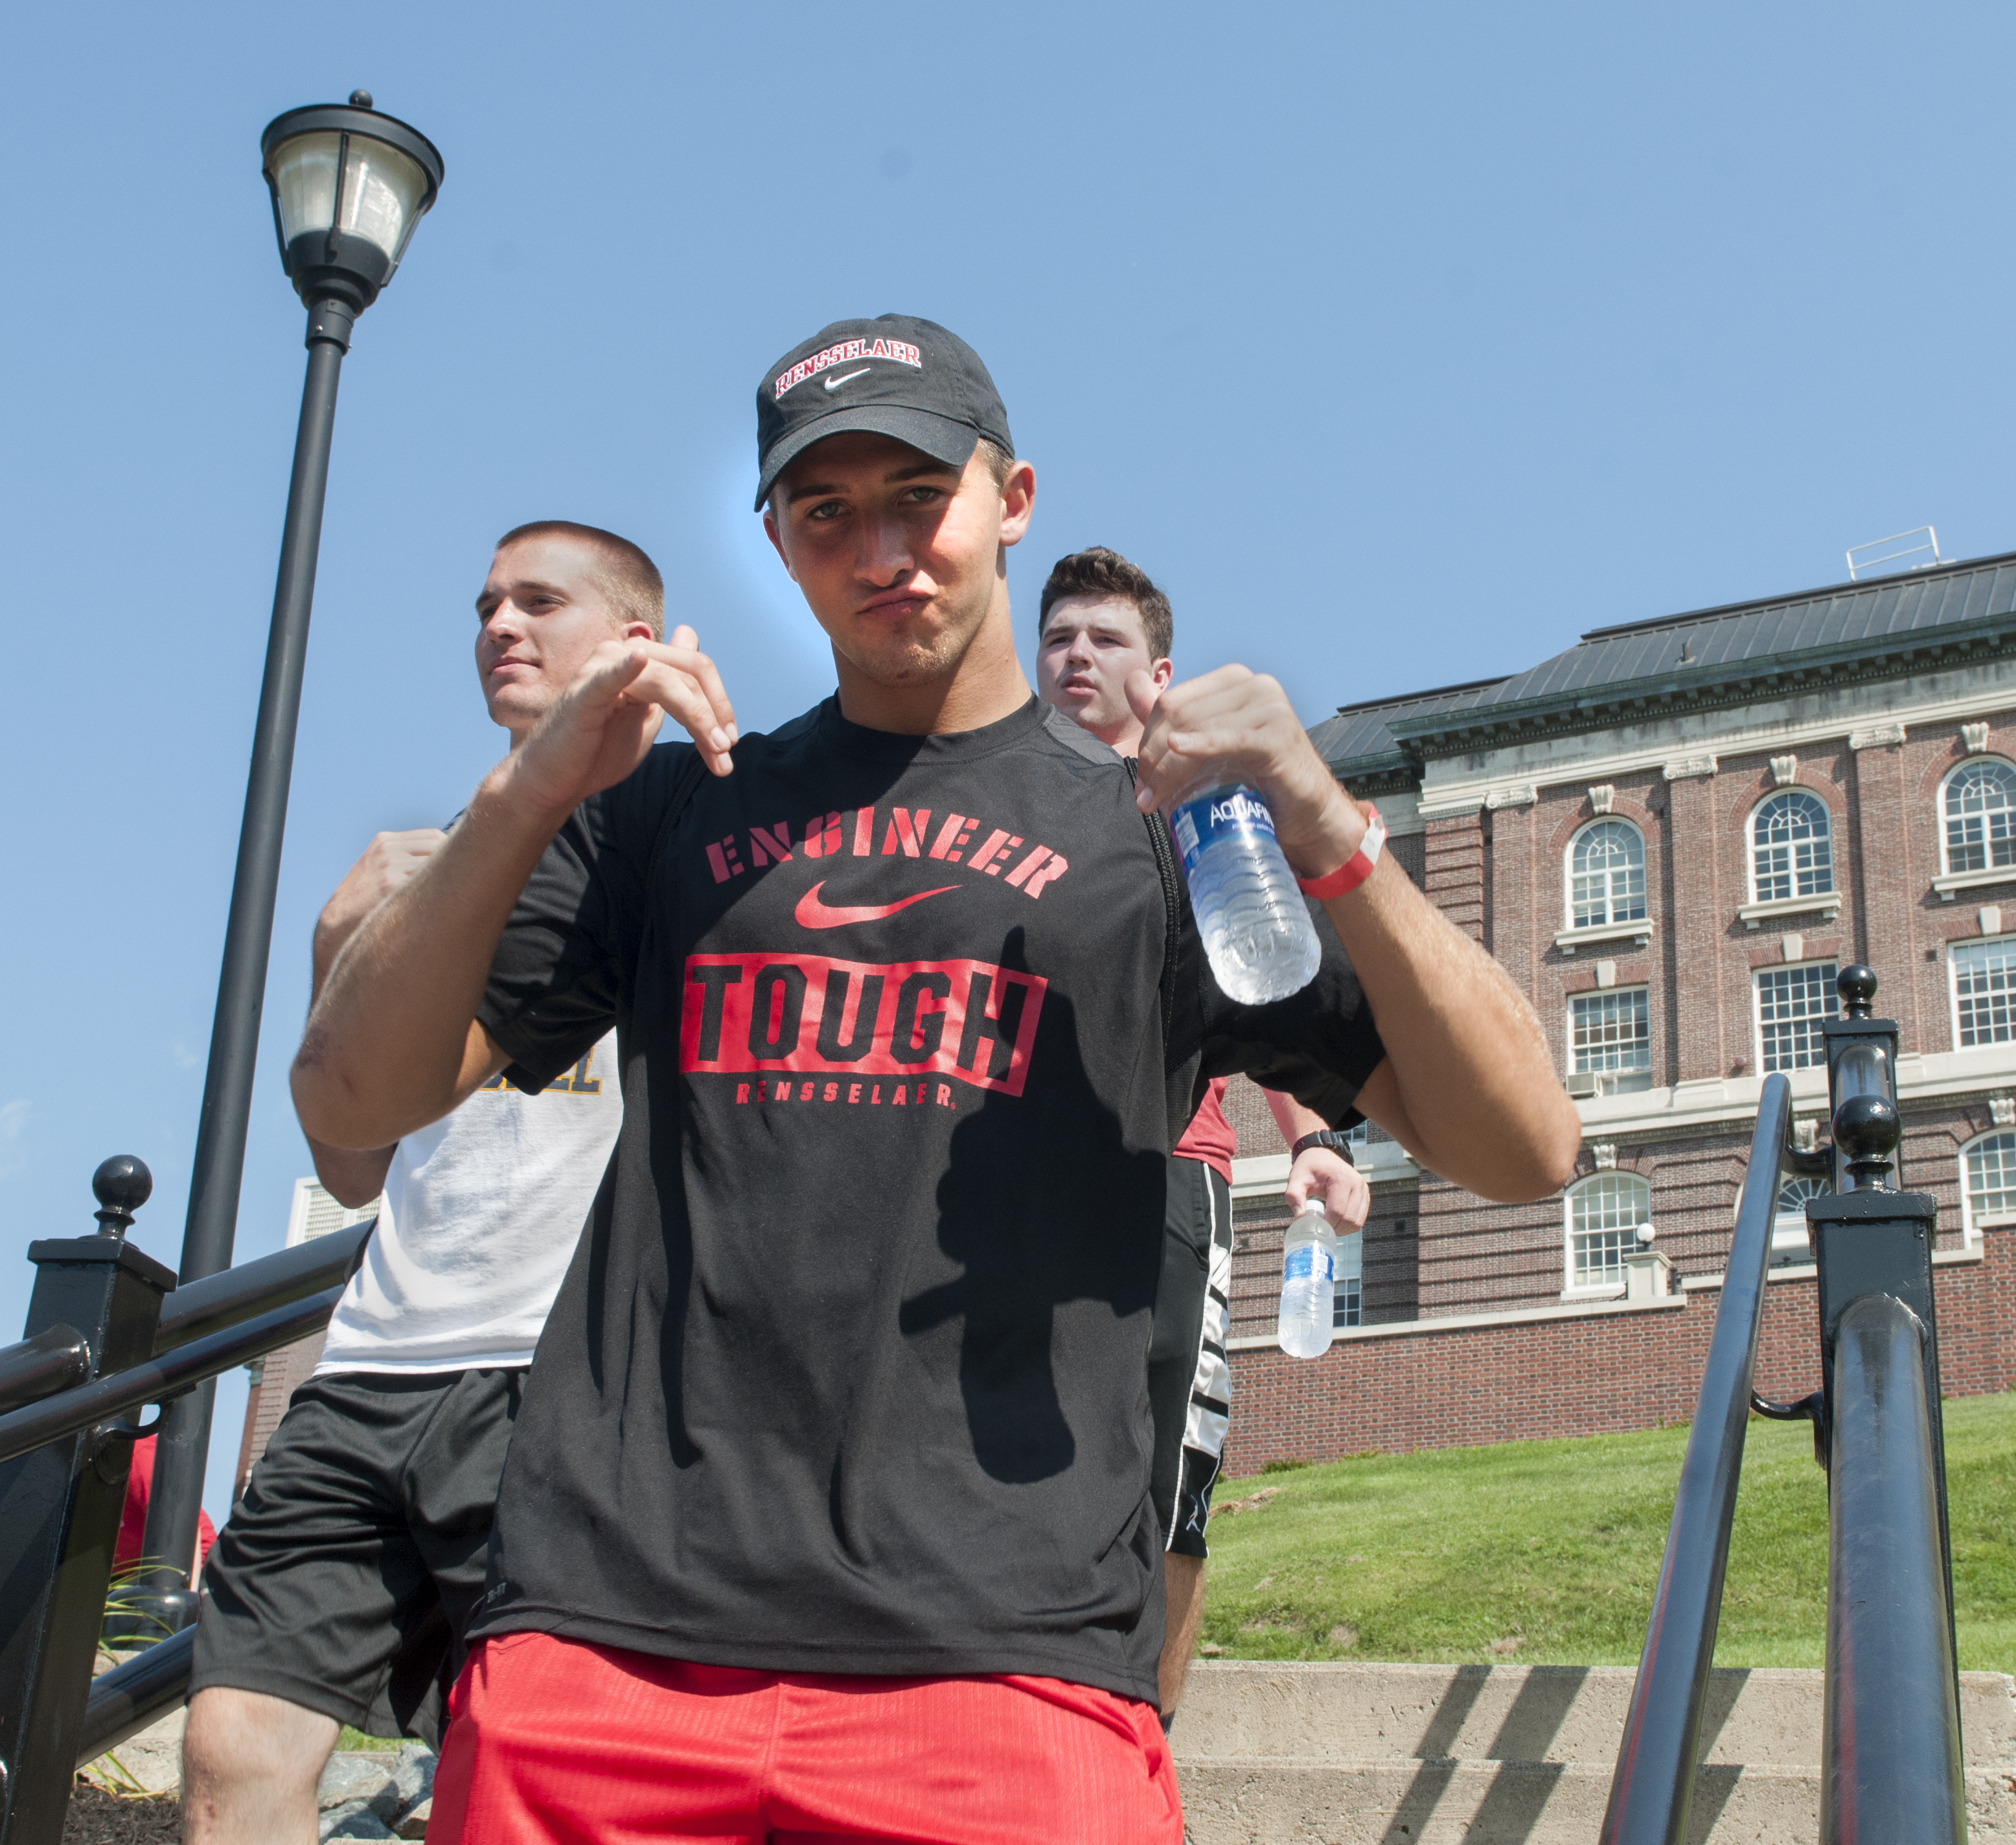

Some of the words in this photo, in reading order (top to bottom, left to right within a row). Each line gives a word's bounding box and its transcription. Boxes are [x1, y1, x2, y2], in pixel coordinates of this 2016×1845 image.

[775, 338, 922, 400] RENSSELAER
[705, 807, 1068, 899] ENGINEER
[693, 963, 1029, 1083] TOUGH
[736, 1081, 951, 1106] RENSSELAER
